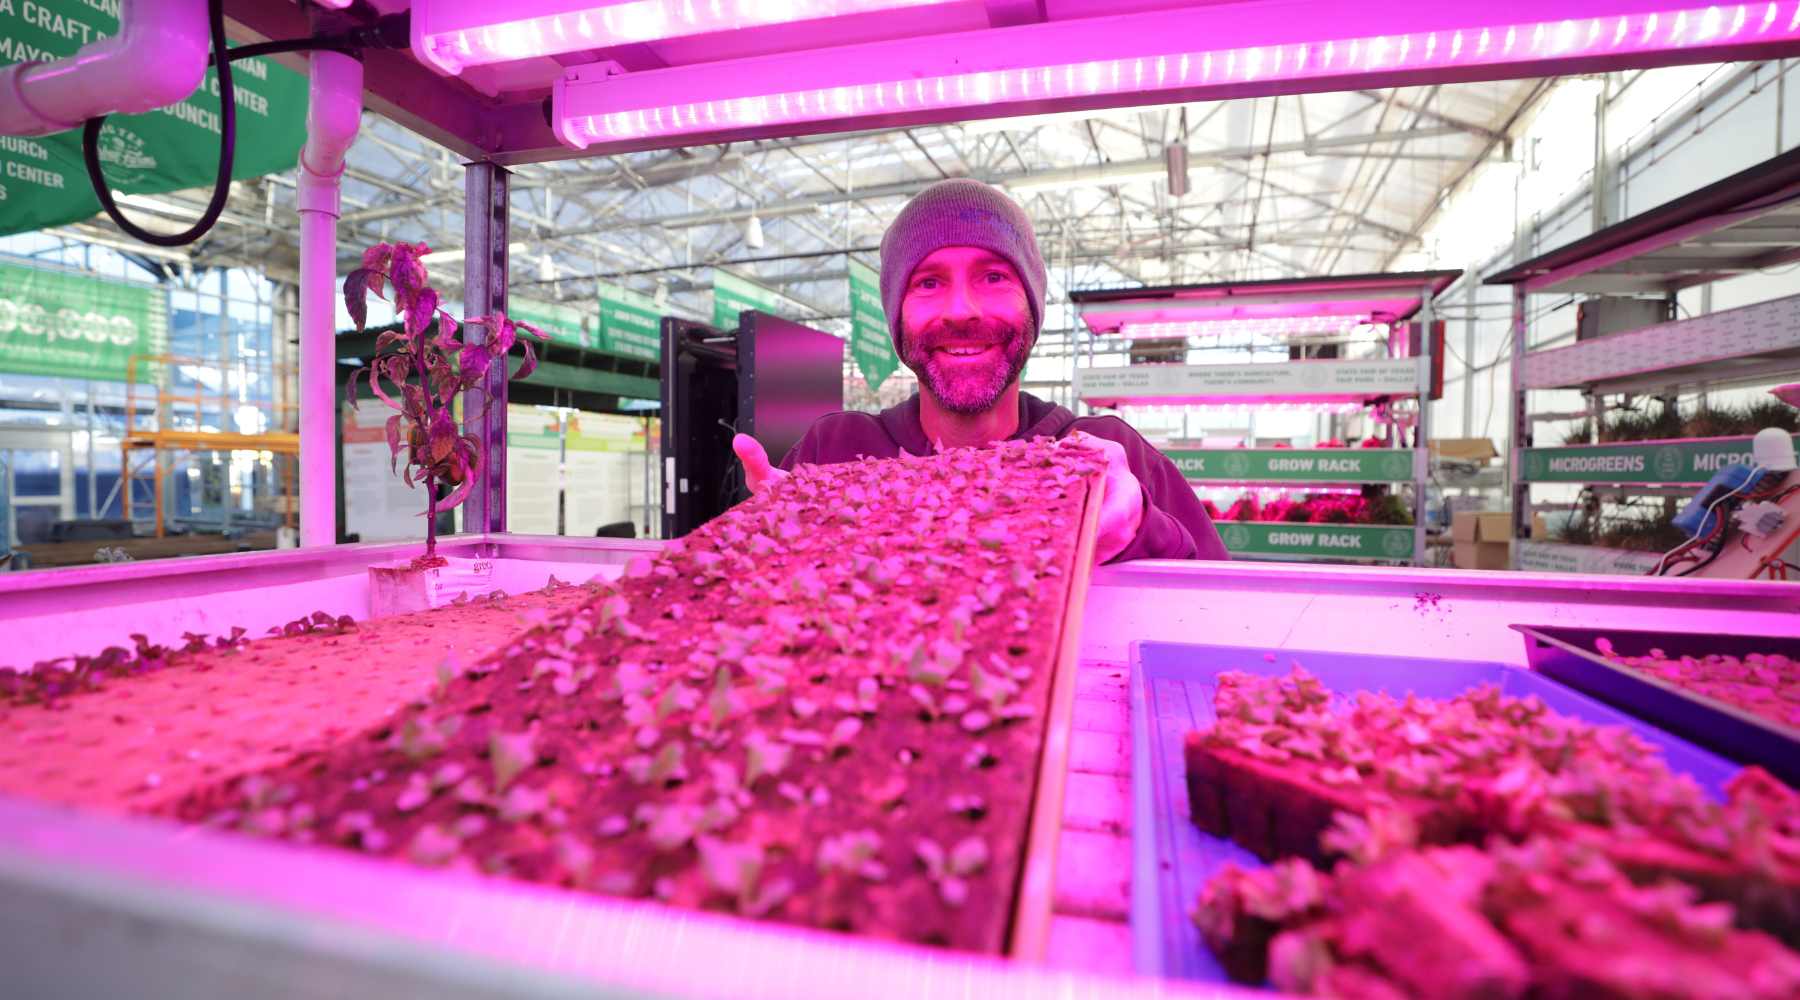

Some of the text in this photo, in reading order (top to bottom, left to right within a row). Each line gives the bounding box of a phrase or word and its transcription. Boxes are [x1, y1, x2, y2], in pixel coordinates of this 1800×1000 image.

[23, 0, 91, 45] CRAFT
[7, 160, 65, 189] CENTER
[1170, 458, 1205, 471] ACK
[1268, 458, 1361, 472] GROW RACK
[1549, 455, 1645, 473] MICROGREENS
[1268, 532, 1362, 548] GROW RACK
